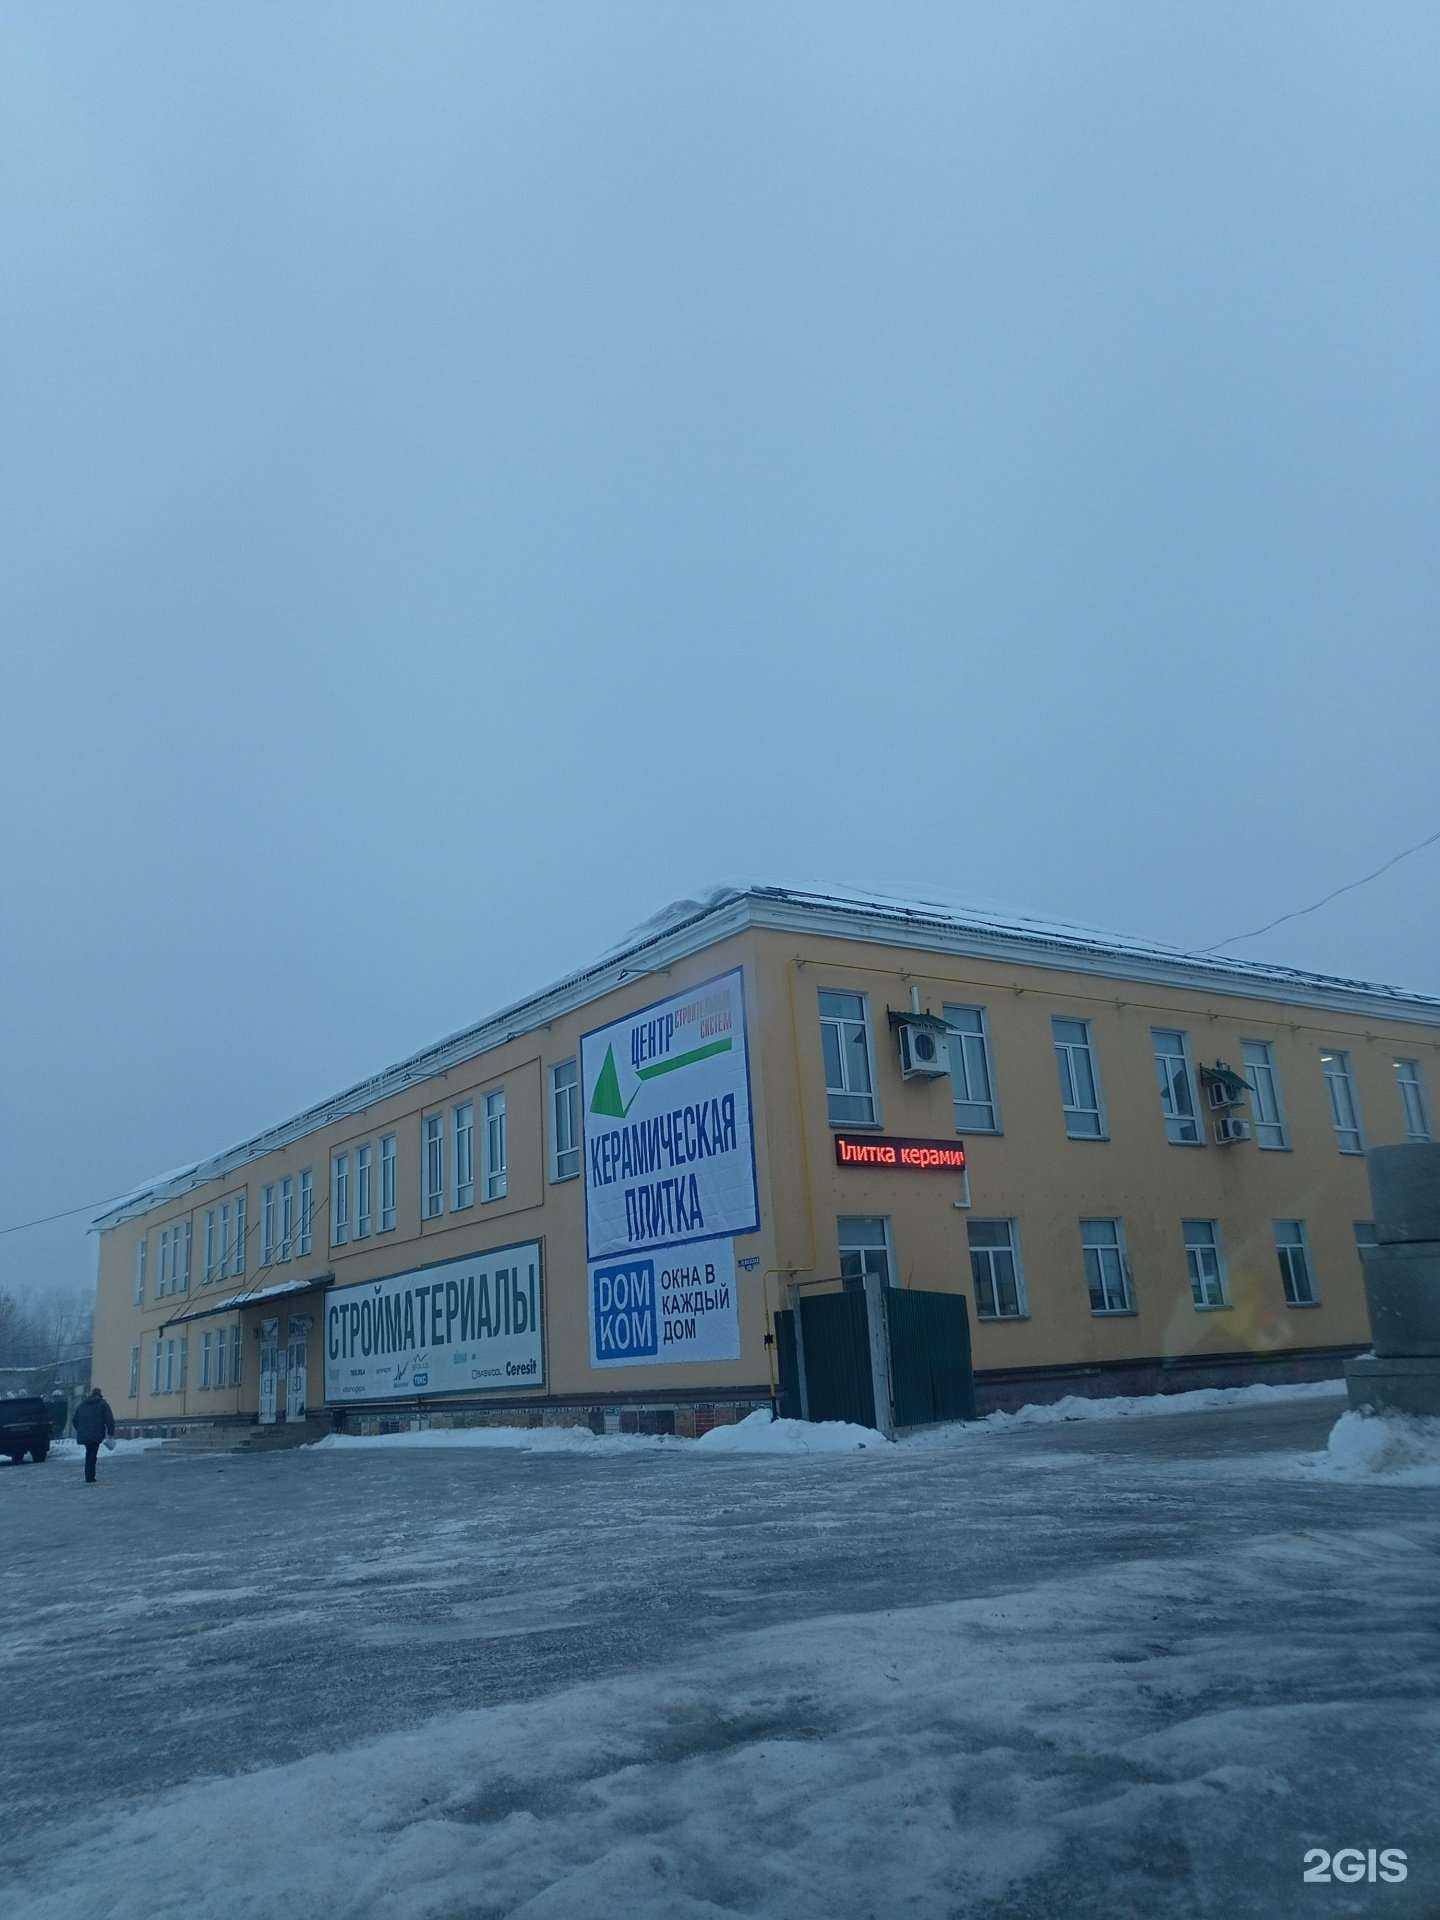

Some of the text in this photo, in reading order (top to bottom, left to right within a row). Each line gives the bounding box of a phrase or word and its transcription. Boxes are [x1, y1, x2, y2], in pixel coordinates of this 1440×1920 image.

[631, 1012, 674, 1069] ЦЕНТР
[590, 1093, 737, 1188] КЕРАМИЧЕСКАЯ
[901, 1147, 964, 1168] керами
[624, 1173, 704, 1243] ПЛИТКА
[661, 1266, 701, 1290] ОКНА
[705, 1263, 715, 1284] В
[328, 1263, 536, 1361] СТРОЙМАТЕРИАЛЫ
[662, 1282, 730, 1316] КАЖДЫЙ
[663, 1318, 696, 1345] ДОМ
[506, 1358, 537, 1376] Ceresit
